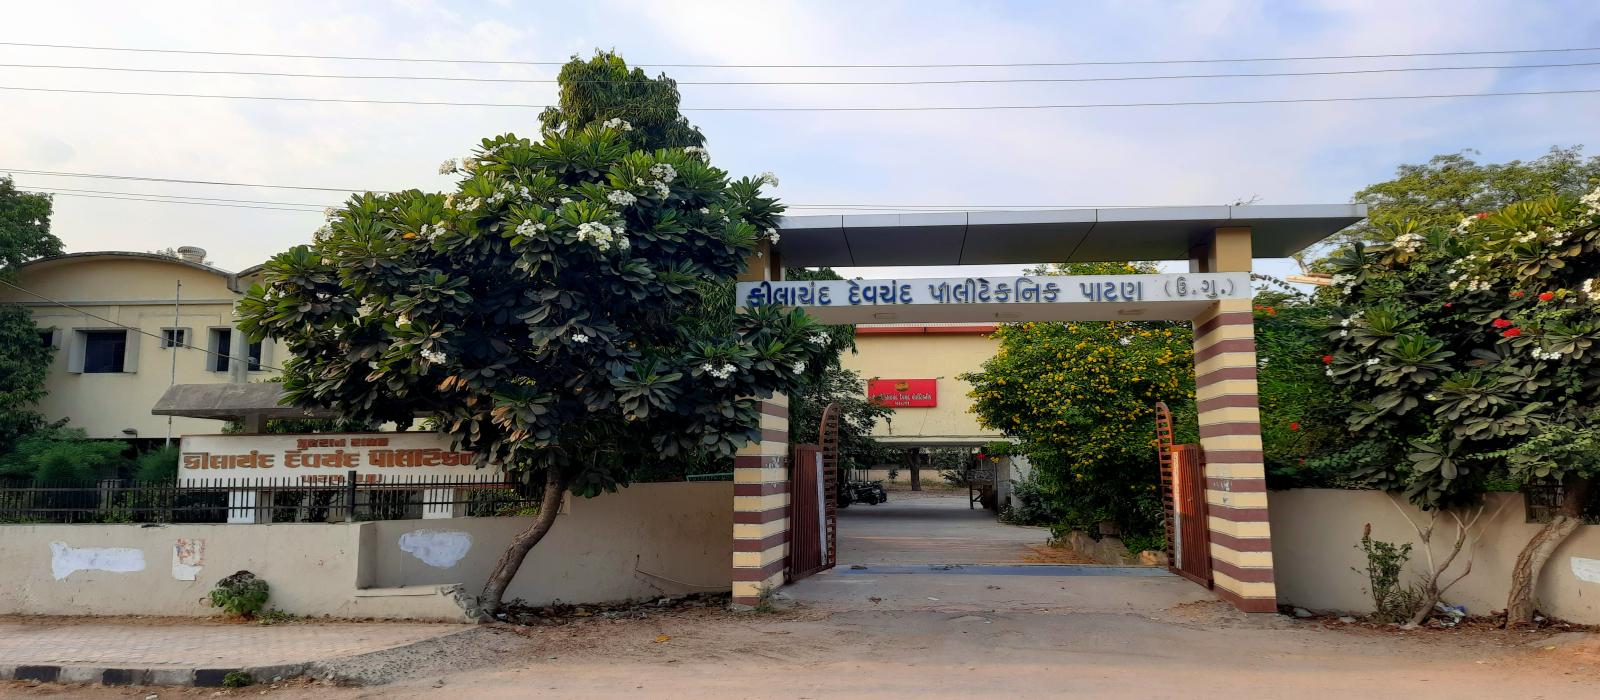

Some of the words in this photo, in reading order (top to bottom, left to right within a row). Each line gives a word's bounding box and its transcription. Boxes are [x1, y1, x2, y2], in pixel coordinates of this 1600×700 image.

[747, 280, 832, 307] કીલાચંદ
[847, 279, 912, 305] દેવચંદ
[1079, 280, 1143, 302] પાટણ
